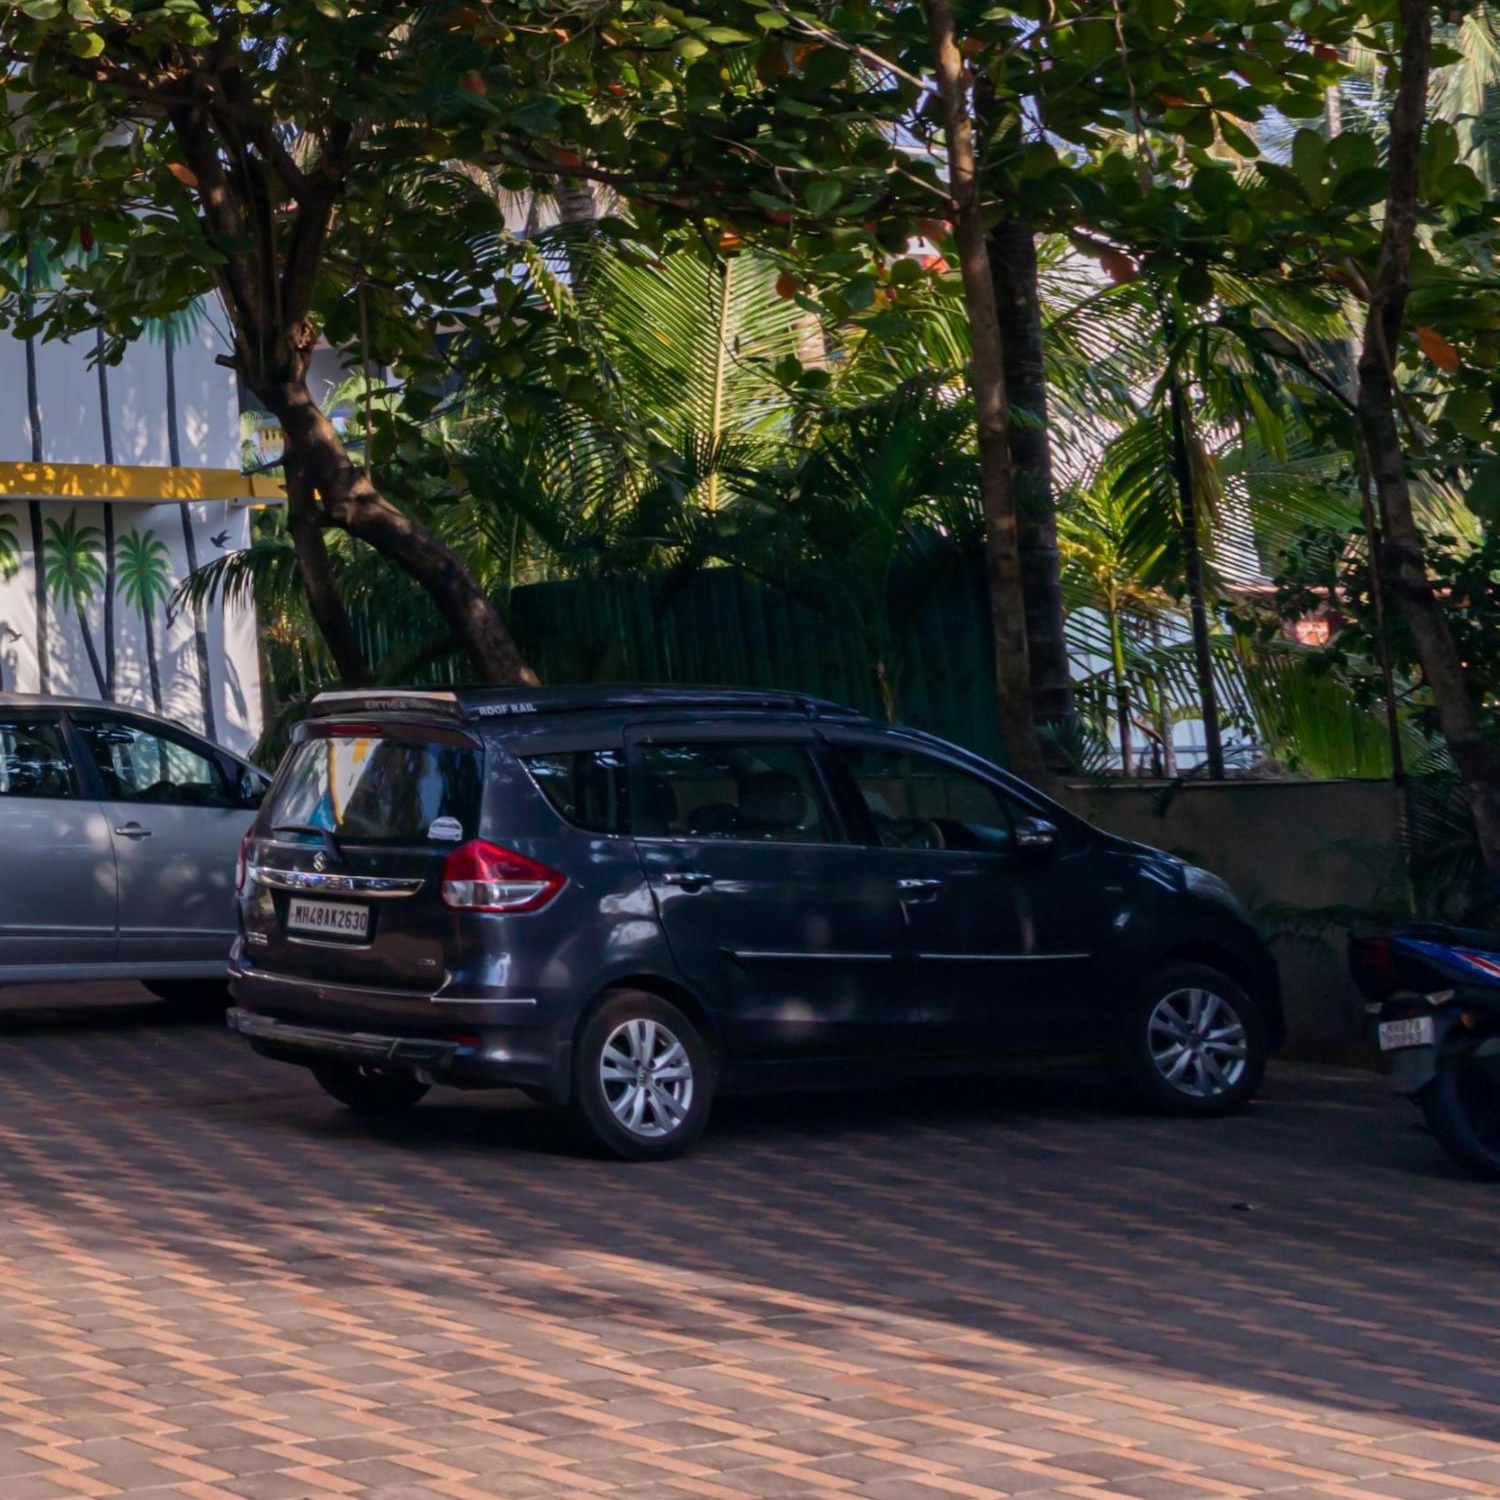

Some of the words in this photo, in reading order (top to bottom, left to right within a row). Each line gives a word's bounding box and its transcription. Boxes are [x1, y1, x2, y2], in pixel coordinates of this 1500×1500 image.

[478, 704, 508, 716] ROOF
[511, 702, 538, 713] RAIL
[294, 905, 368, 931] MH48AK2630
